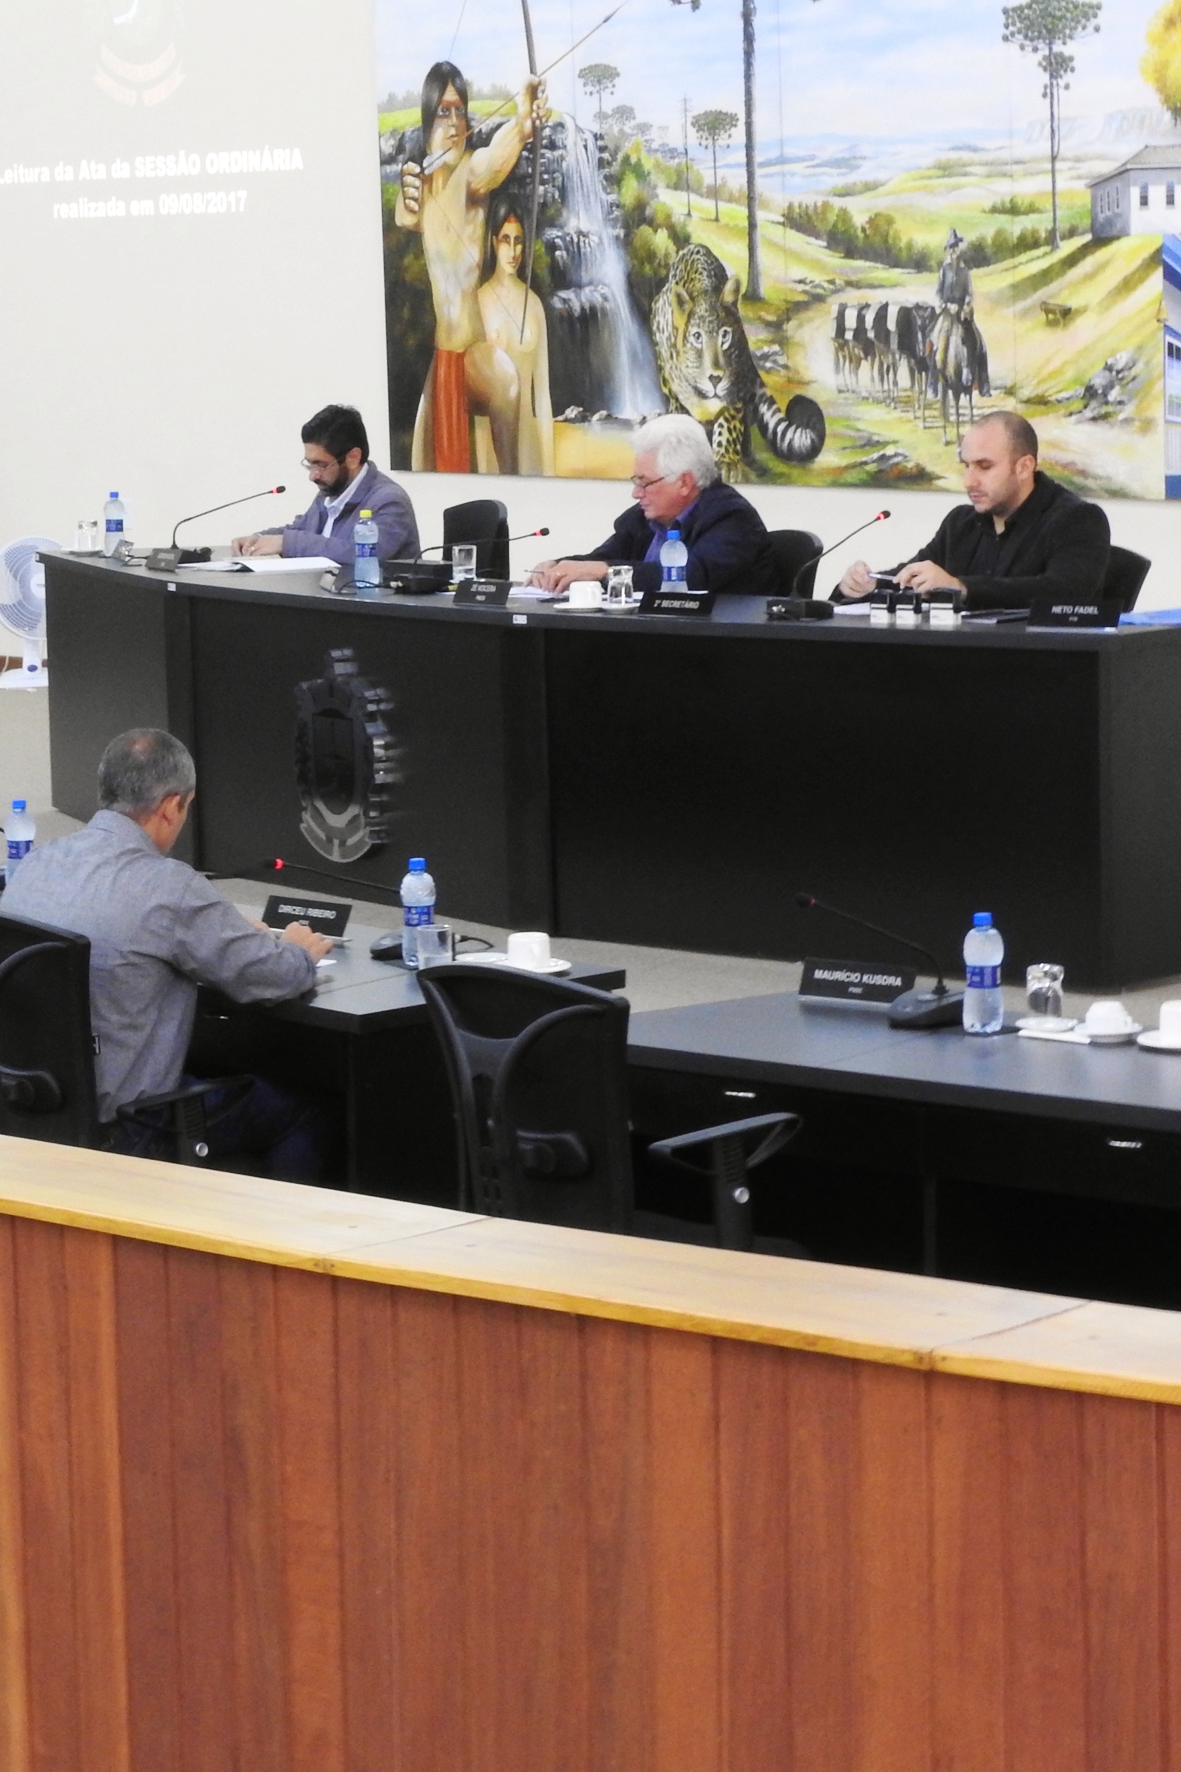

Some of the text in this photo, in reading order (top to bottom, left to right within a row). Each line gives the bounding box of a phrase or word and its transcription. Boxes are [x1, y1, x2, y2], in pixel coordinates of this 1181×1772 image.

[54, 160, 75, 182] da
[78, 159, 107, 181] Ata
[111, 157, 131, 179] da
[134, 150, 201, 178] SESSÃO
[205, 145, 304, 174] ORDINÁRIA
[52, 190, 248, 220] realizada em 09/08/2017
[1051, 605, 1099, 615] NETO FADEL
[278, 904, 337, 920] DIRCEU RIBEIRO
[814, 969, 902, 987] MAURÍCIO KUSDRA
